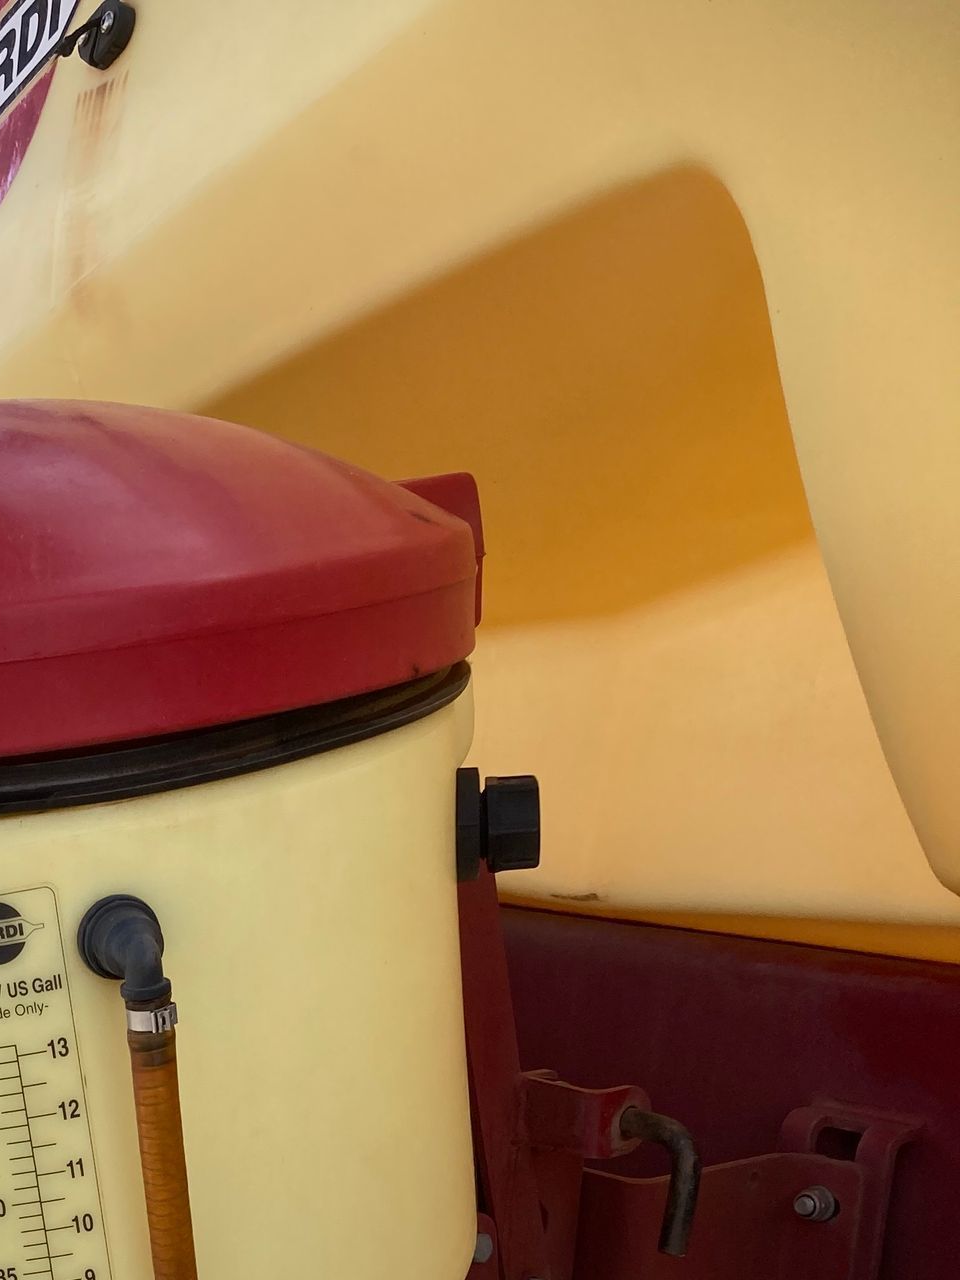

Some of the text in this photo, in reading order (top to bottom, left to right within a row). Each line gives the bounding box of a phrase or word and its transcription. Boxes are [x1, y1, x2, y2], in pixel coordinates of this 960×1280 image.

[7, 981, 28, 998] US
[32, 973, 63, 994] Gall
[15, 1001, 49, 1018] Only-
[48, 1038, 69, 1058] 13
[59, 1100, 80, 1120] 12
[67, 1158, 84, 1178] 11
[73, 1214, 93, 1233] 10
